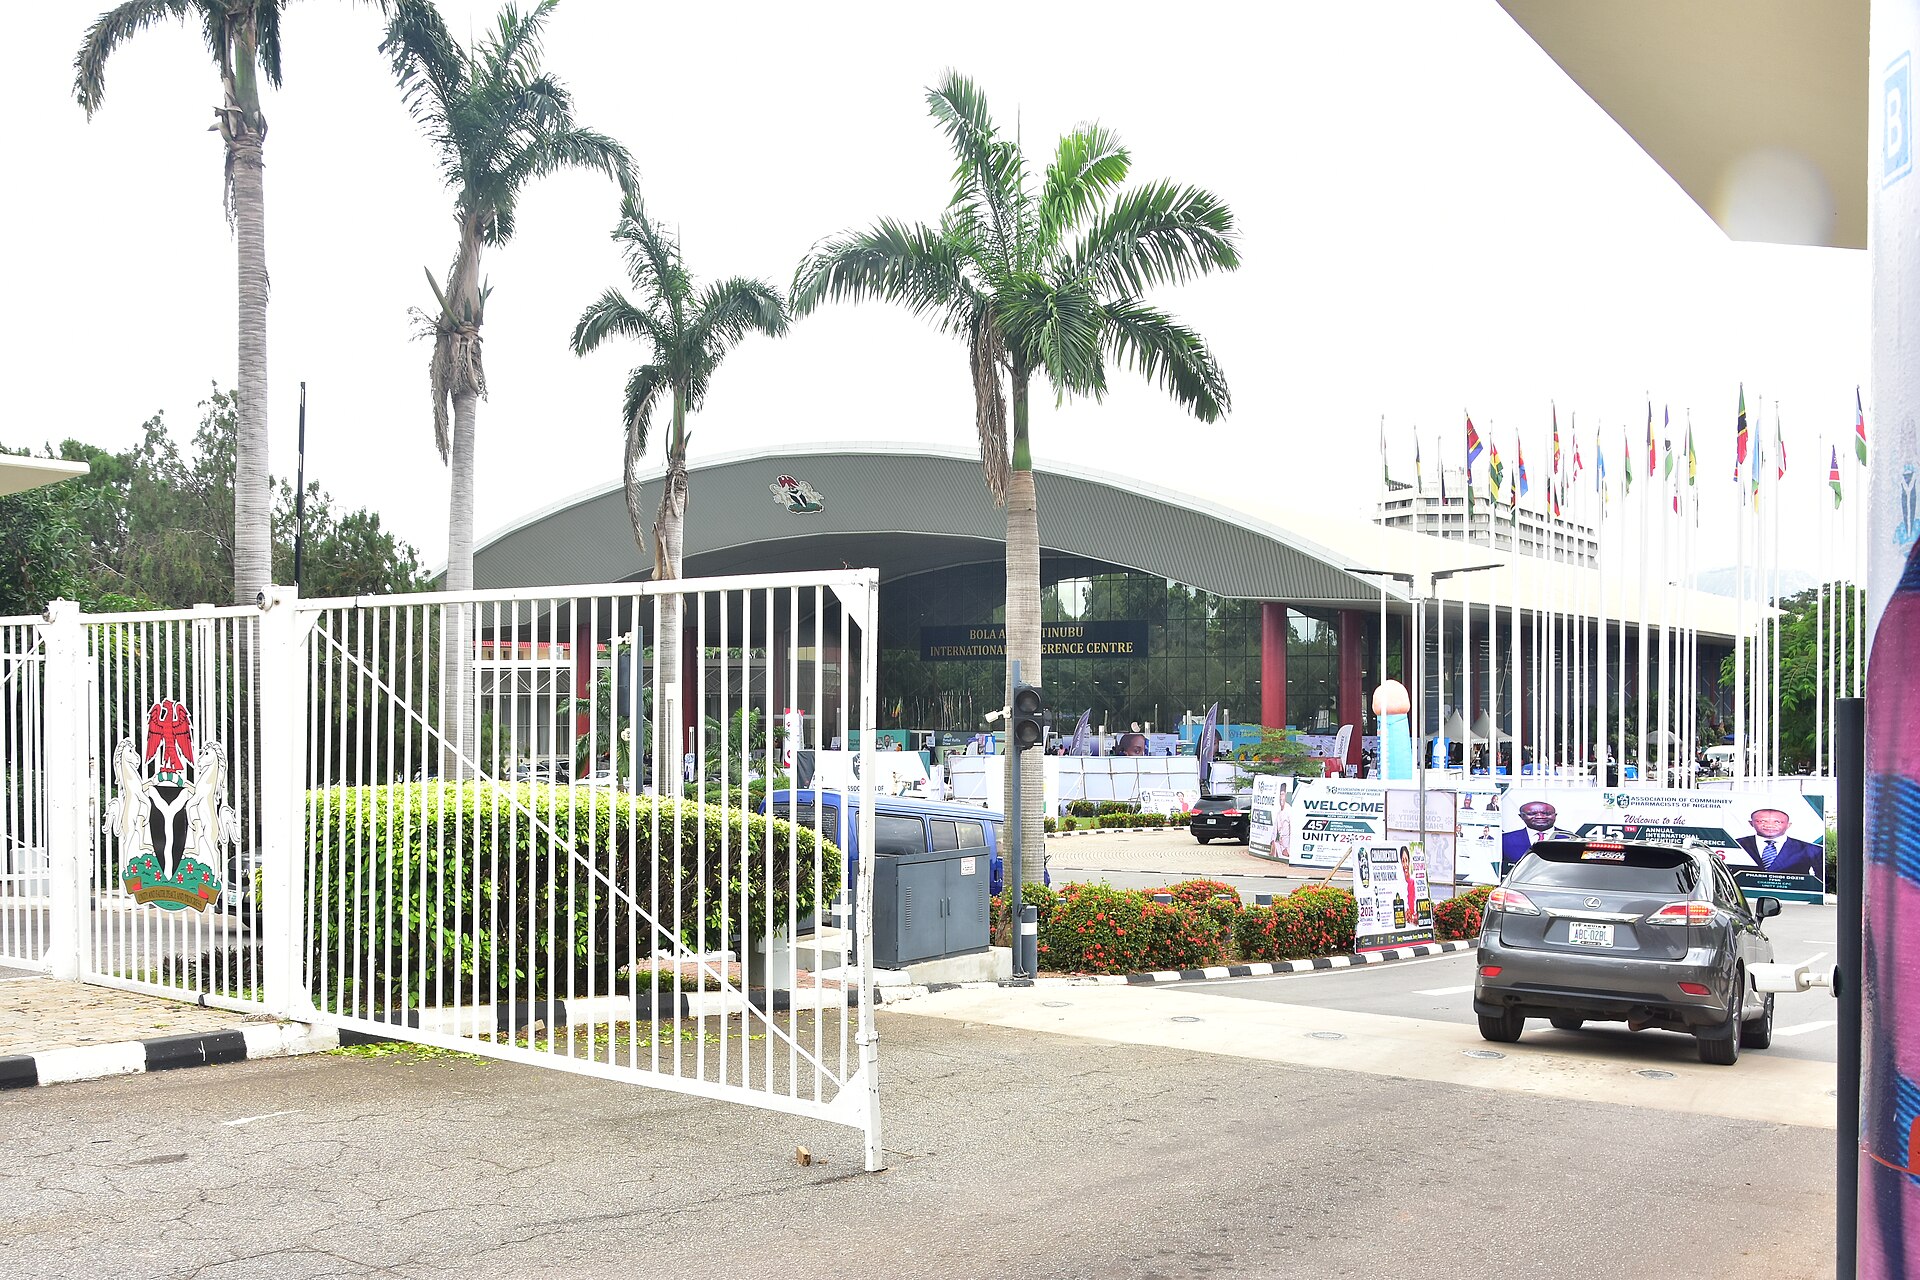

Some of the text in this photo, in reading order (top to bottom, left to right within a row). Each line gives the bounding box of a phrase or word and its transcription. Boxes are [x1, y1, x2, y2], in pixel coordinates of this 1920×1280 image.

[969, 629, 996, 640] BOLA
[1041, 626, 1083, 638] TINUBU
[1041, 643, 1084, 655] ERENCE
[1086, 641, 1133, 654] CENTRE
[1303, 800, 1385, 813] WELCOME
[1307, 820, 1323, 831] 45
[1623, 814, 1686, 825] Welcome to the
[1302, 832, 1340, 842] UNITY
[1585, 825, 1625, 842] 45
